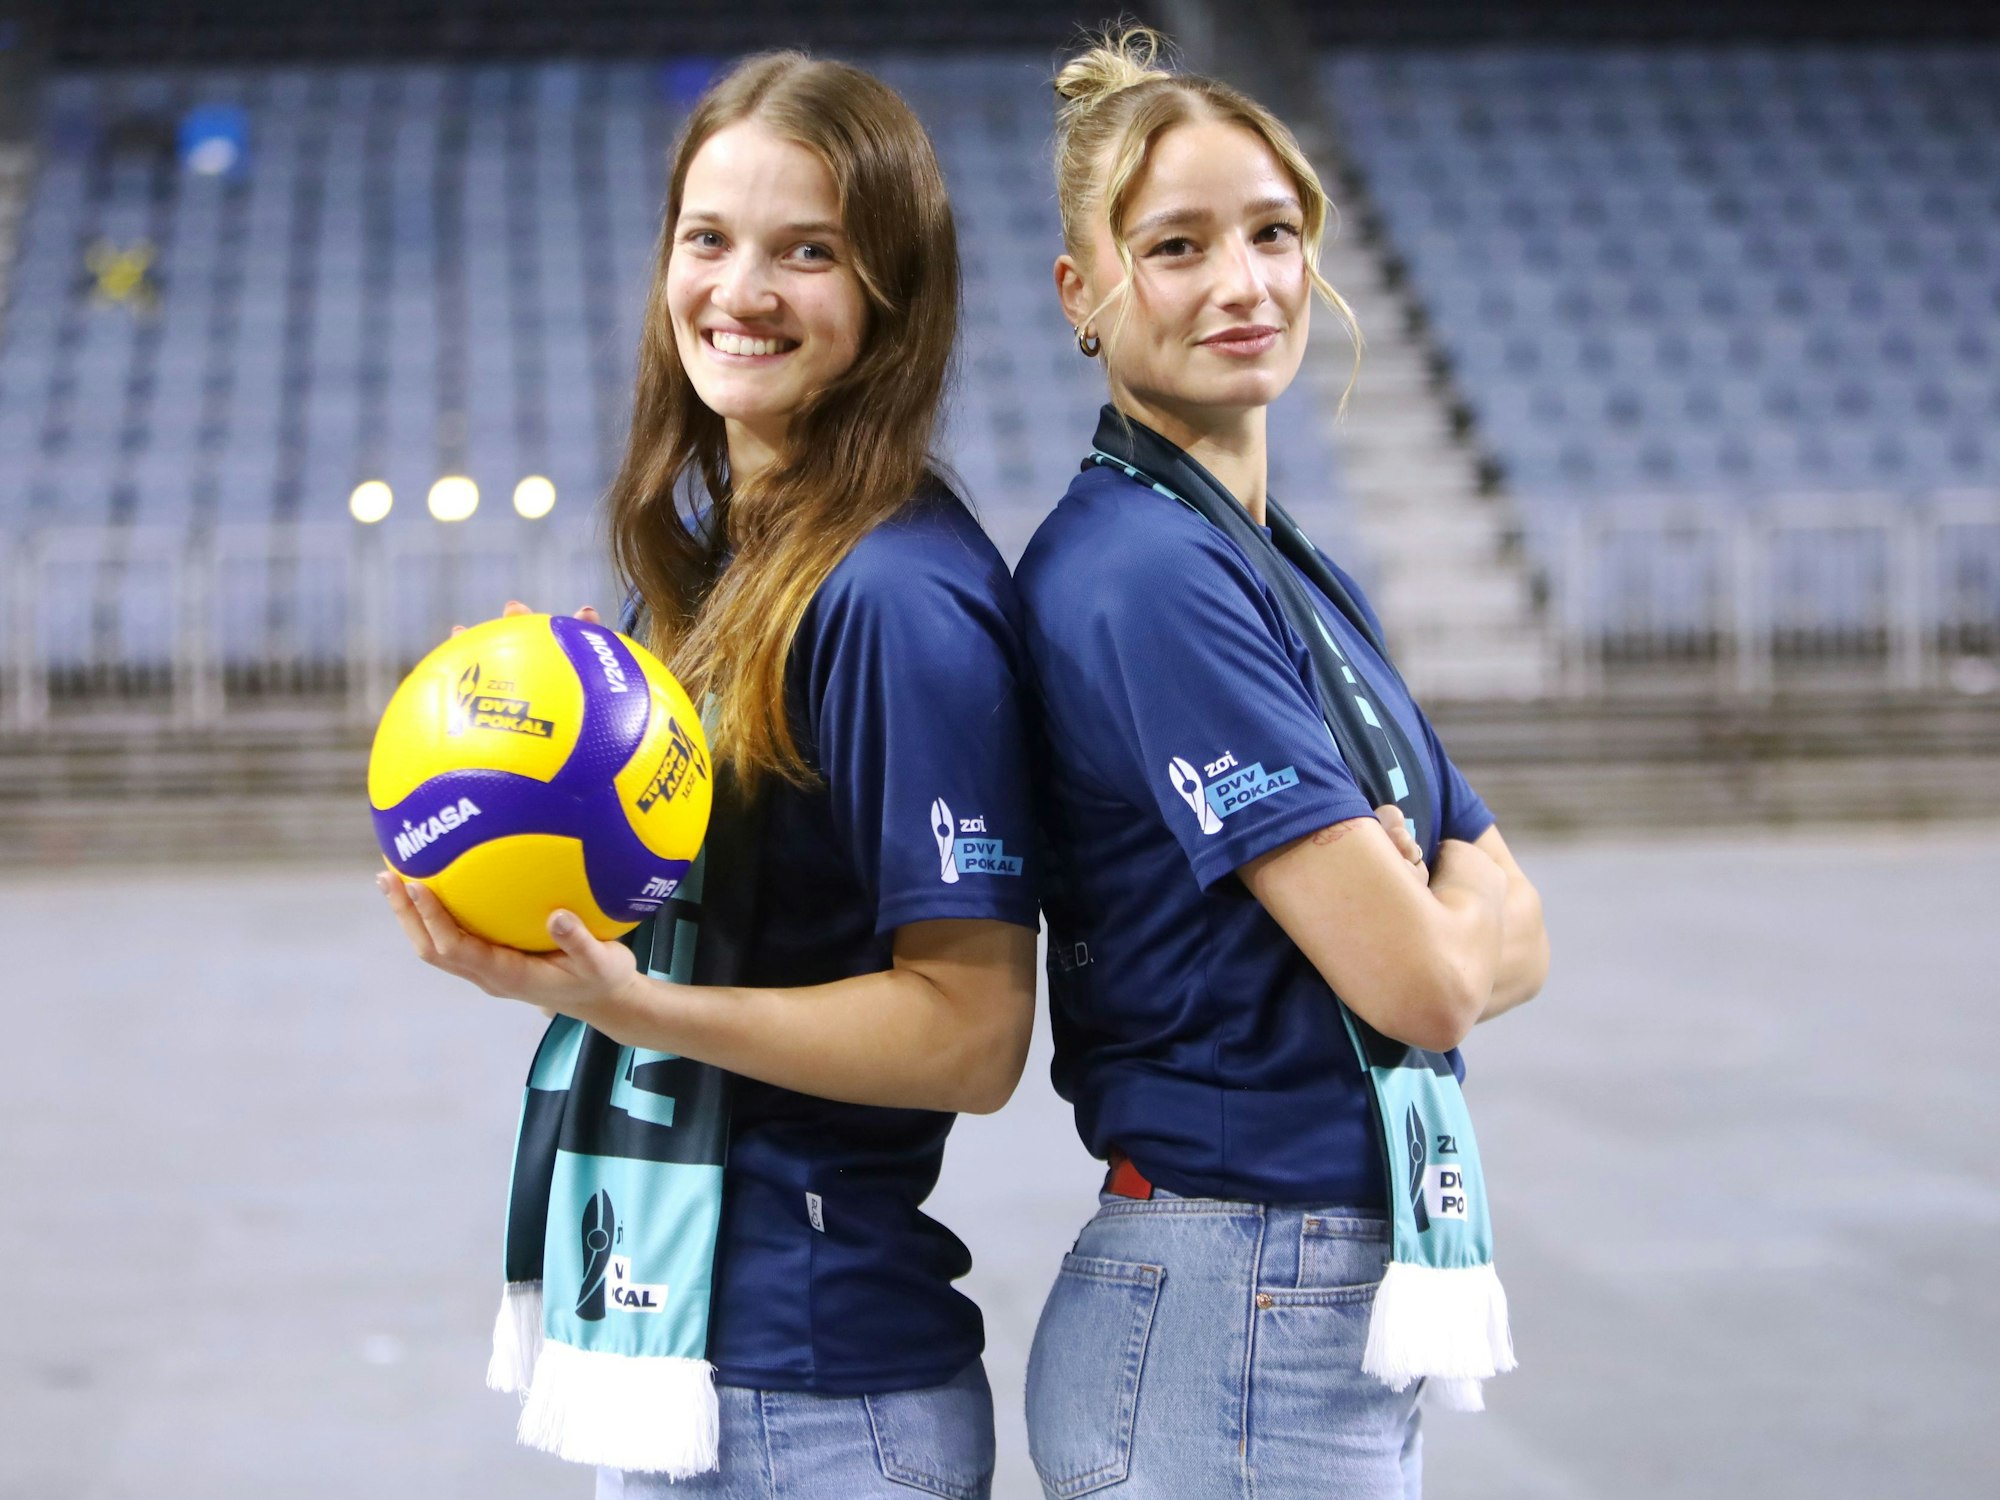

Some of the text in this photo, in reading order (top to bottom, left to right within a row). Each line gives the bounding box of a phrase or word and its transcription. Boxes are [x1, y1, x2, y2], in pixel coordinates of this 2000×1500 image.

[580, 630, 628, 693] V200M
[477, 699, 524, 715] DVV
[474, 713, 547, 736] POKAL
[640, 744, 680, 802] POKAL
[666, 755, 687, 796] DVV
[1203, 750, 1239, 778] zoi
[1215, 769, 1256, 798] DVV
[1223, 775, 1291, 812] POKAL
[959, 815, 987, 833] zoi
[963, 843, 996, 855] DVV
[965, 858, 1016, 872] POKAL
[641, 876, 678, 898] FIVB
